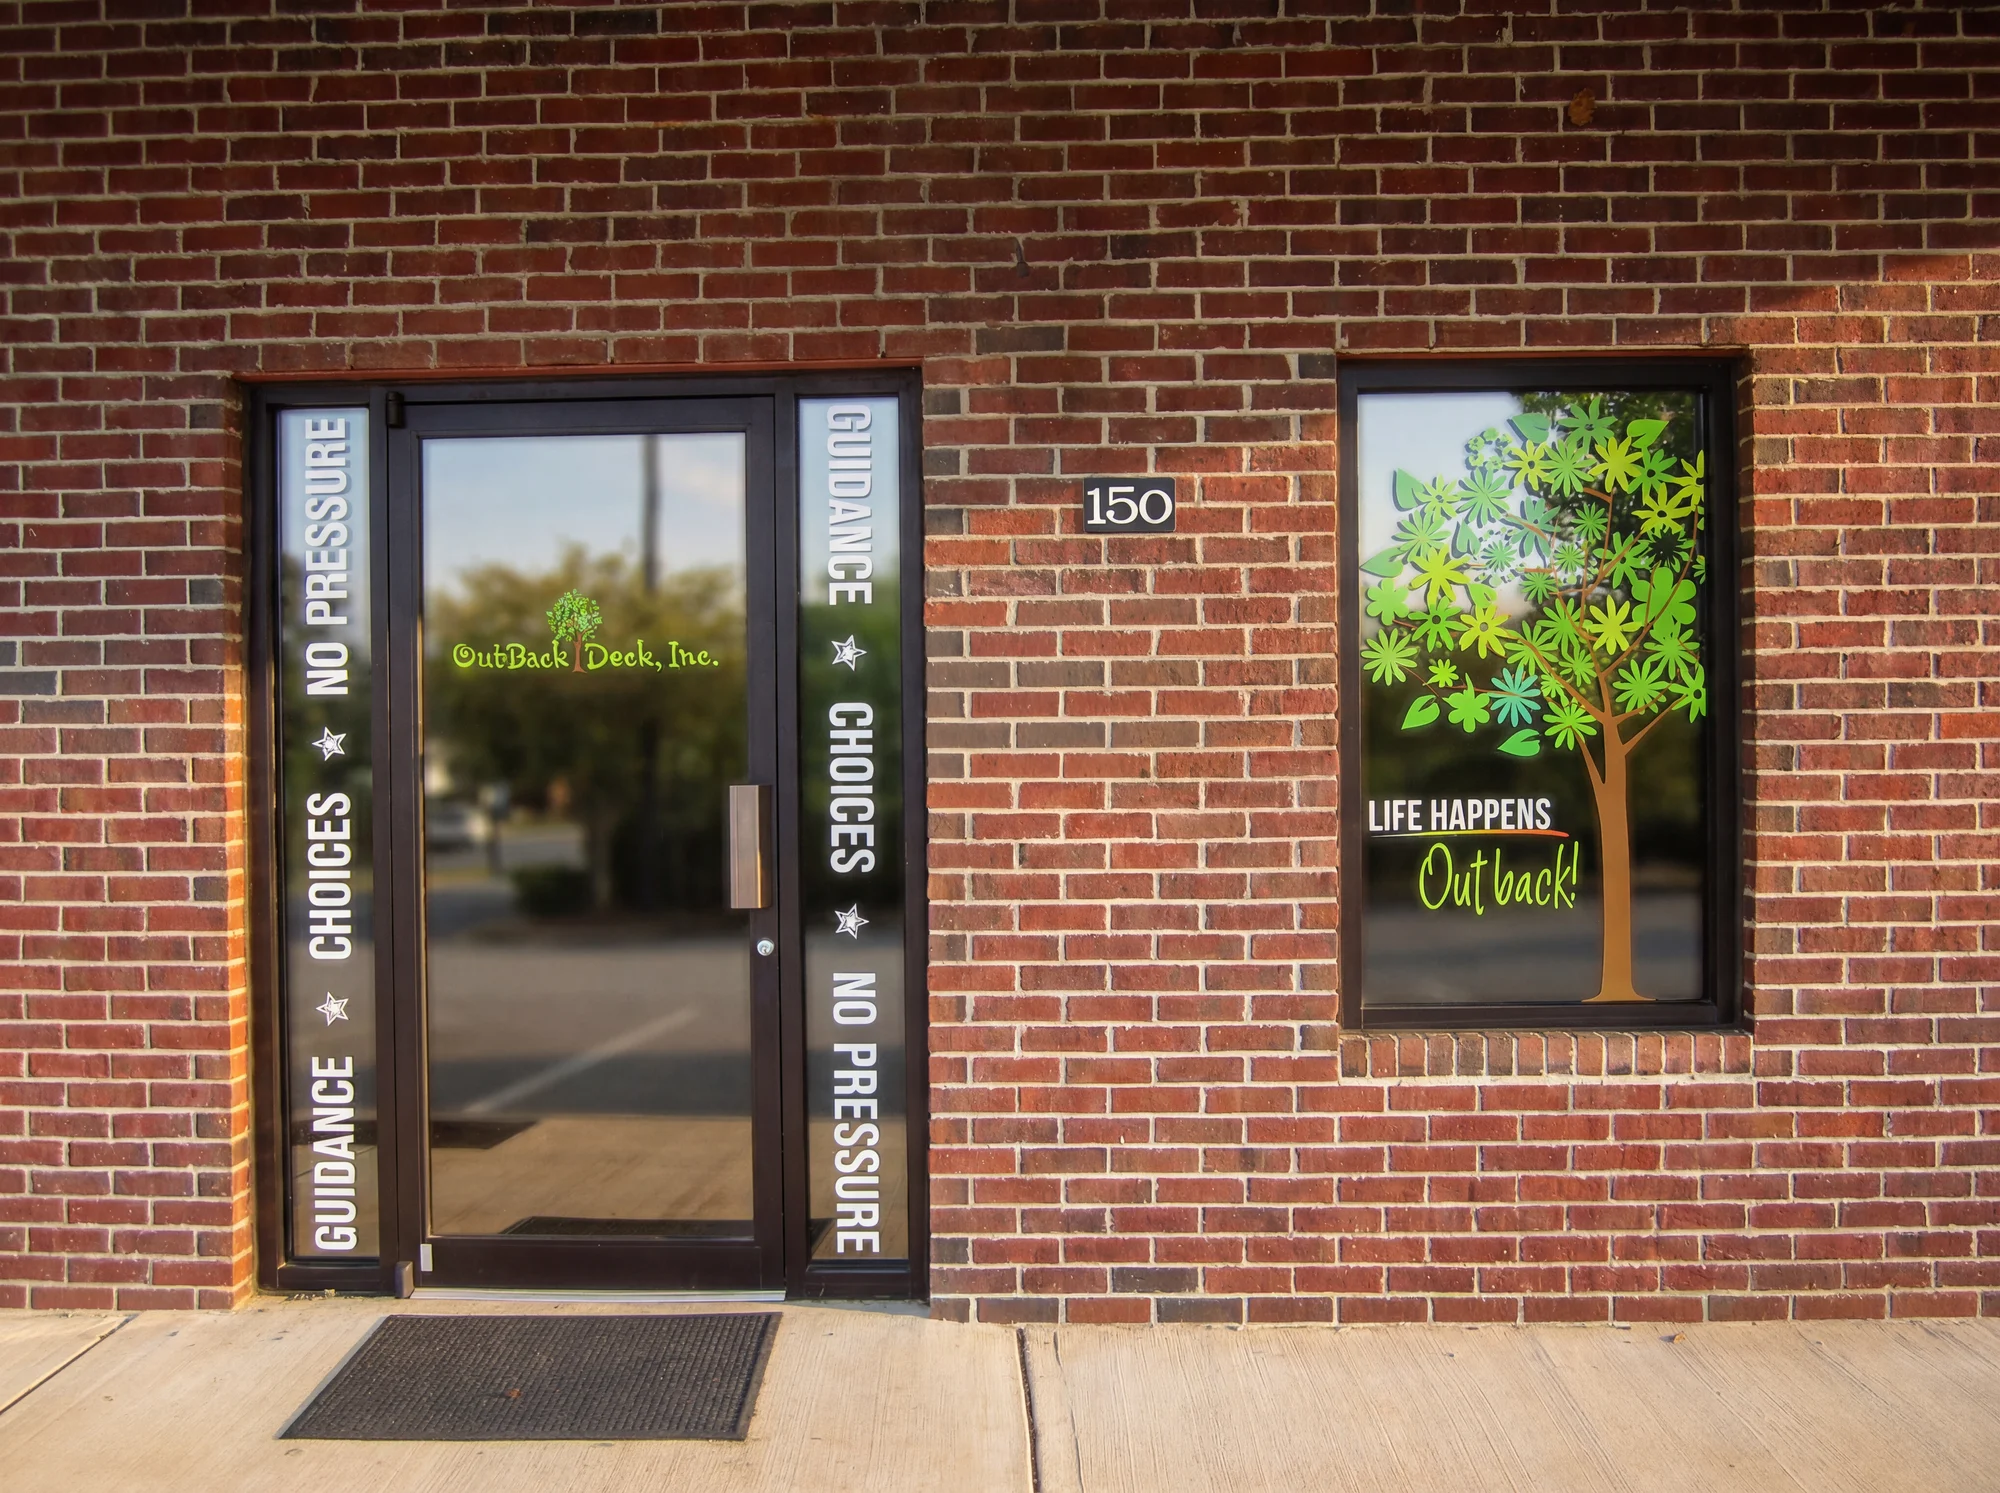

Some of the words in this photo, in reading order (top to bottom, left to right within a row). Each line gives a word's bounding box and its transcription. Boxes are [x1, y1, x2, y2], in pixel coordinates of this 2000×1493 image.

[303, 417, 350, 627] PRESSURE
[826, 404, 873, 606] GUIDANCE
[1087, 486, 1173, 524] 150
[305, 641, 350, 697] NO
[452, 640, 570, 670] OutBack
[584, 639, 664, 672] Deck,
[668, 641, 720, 668] Inc.
[828, 702, 875, 874] CHOICES
[1368, 800, 1422, 831] LIFE
[1430, 798, 1551, 830] HAPPENS
[307, 792, 352, 961] CHOICES
[832, 972, 877, 1026] NO
[311, 1055, 357, 1252] GUIDANCE
[833, 1043, 881, 1254] PRESSURE
